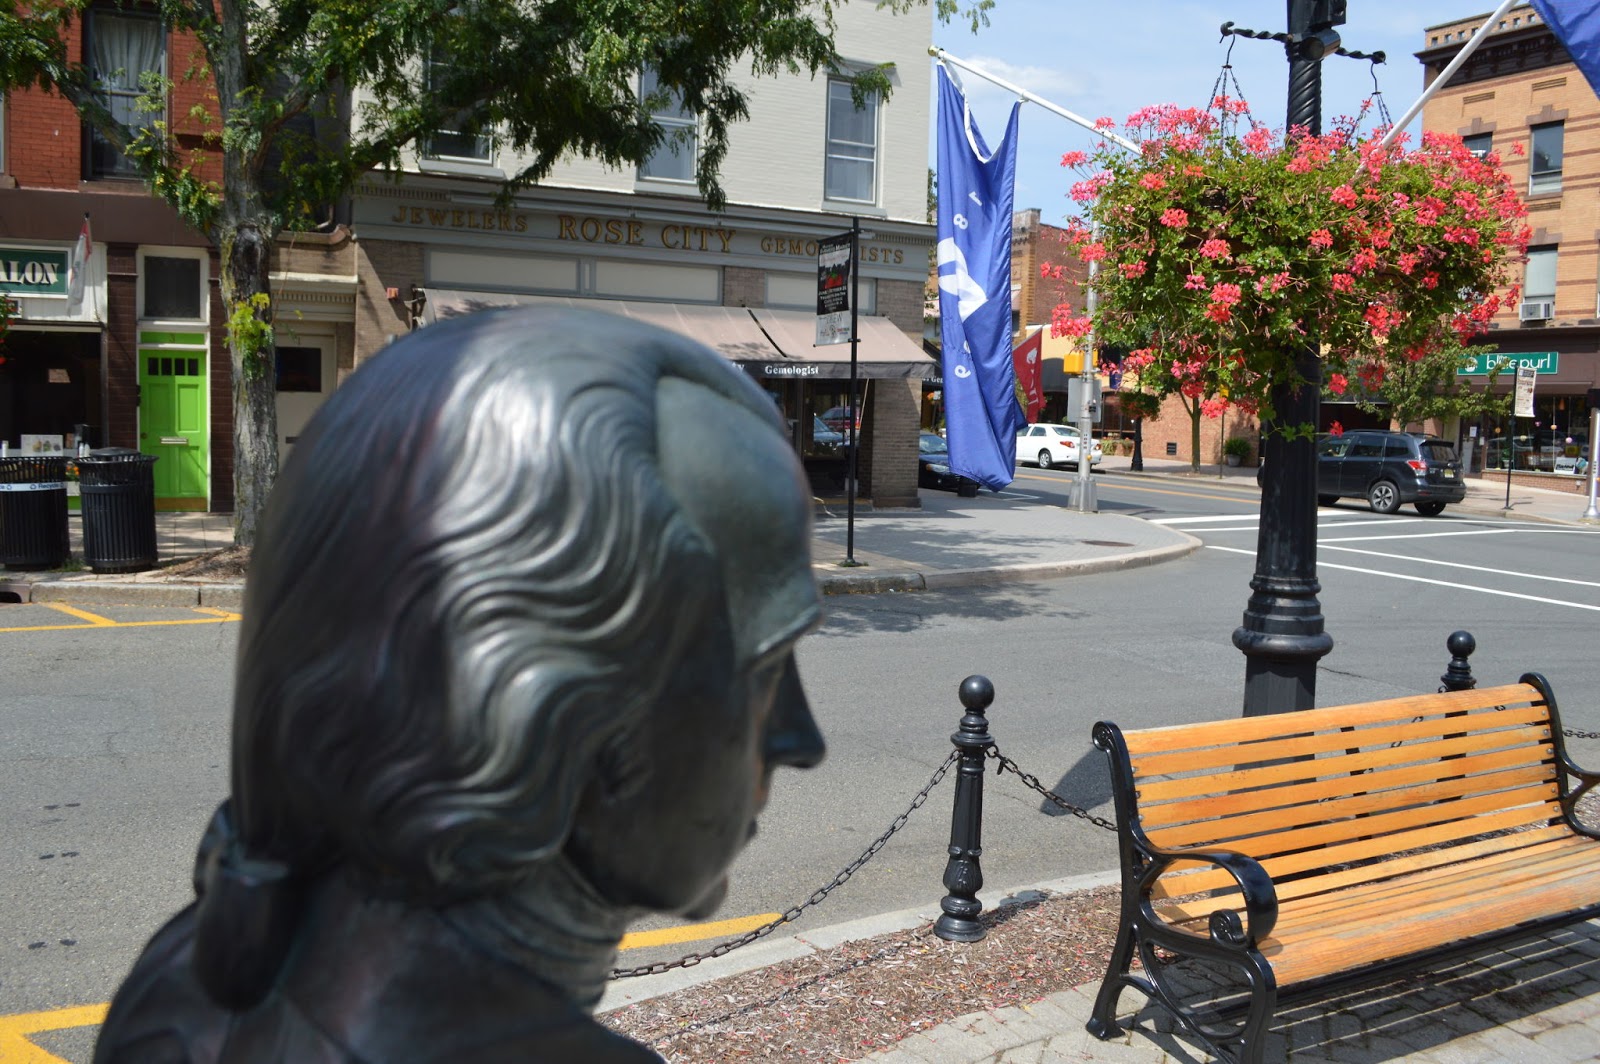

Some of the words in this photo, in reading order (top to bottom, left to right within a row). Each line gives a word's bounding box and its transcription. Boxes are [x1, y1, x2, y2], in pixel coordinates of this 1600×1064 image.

[392, 206, 529, 232] JEWELERS
[557, 214, 645, 246] ROSE
[661, 224, 737, 253] CITY
[760, 236, 905, 265] GEMOISTS
[1519, 352, 1551, 369] purl
[764, 364, 819, 377] Gemologist
